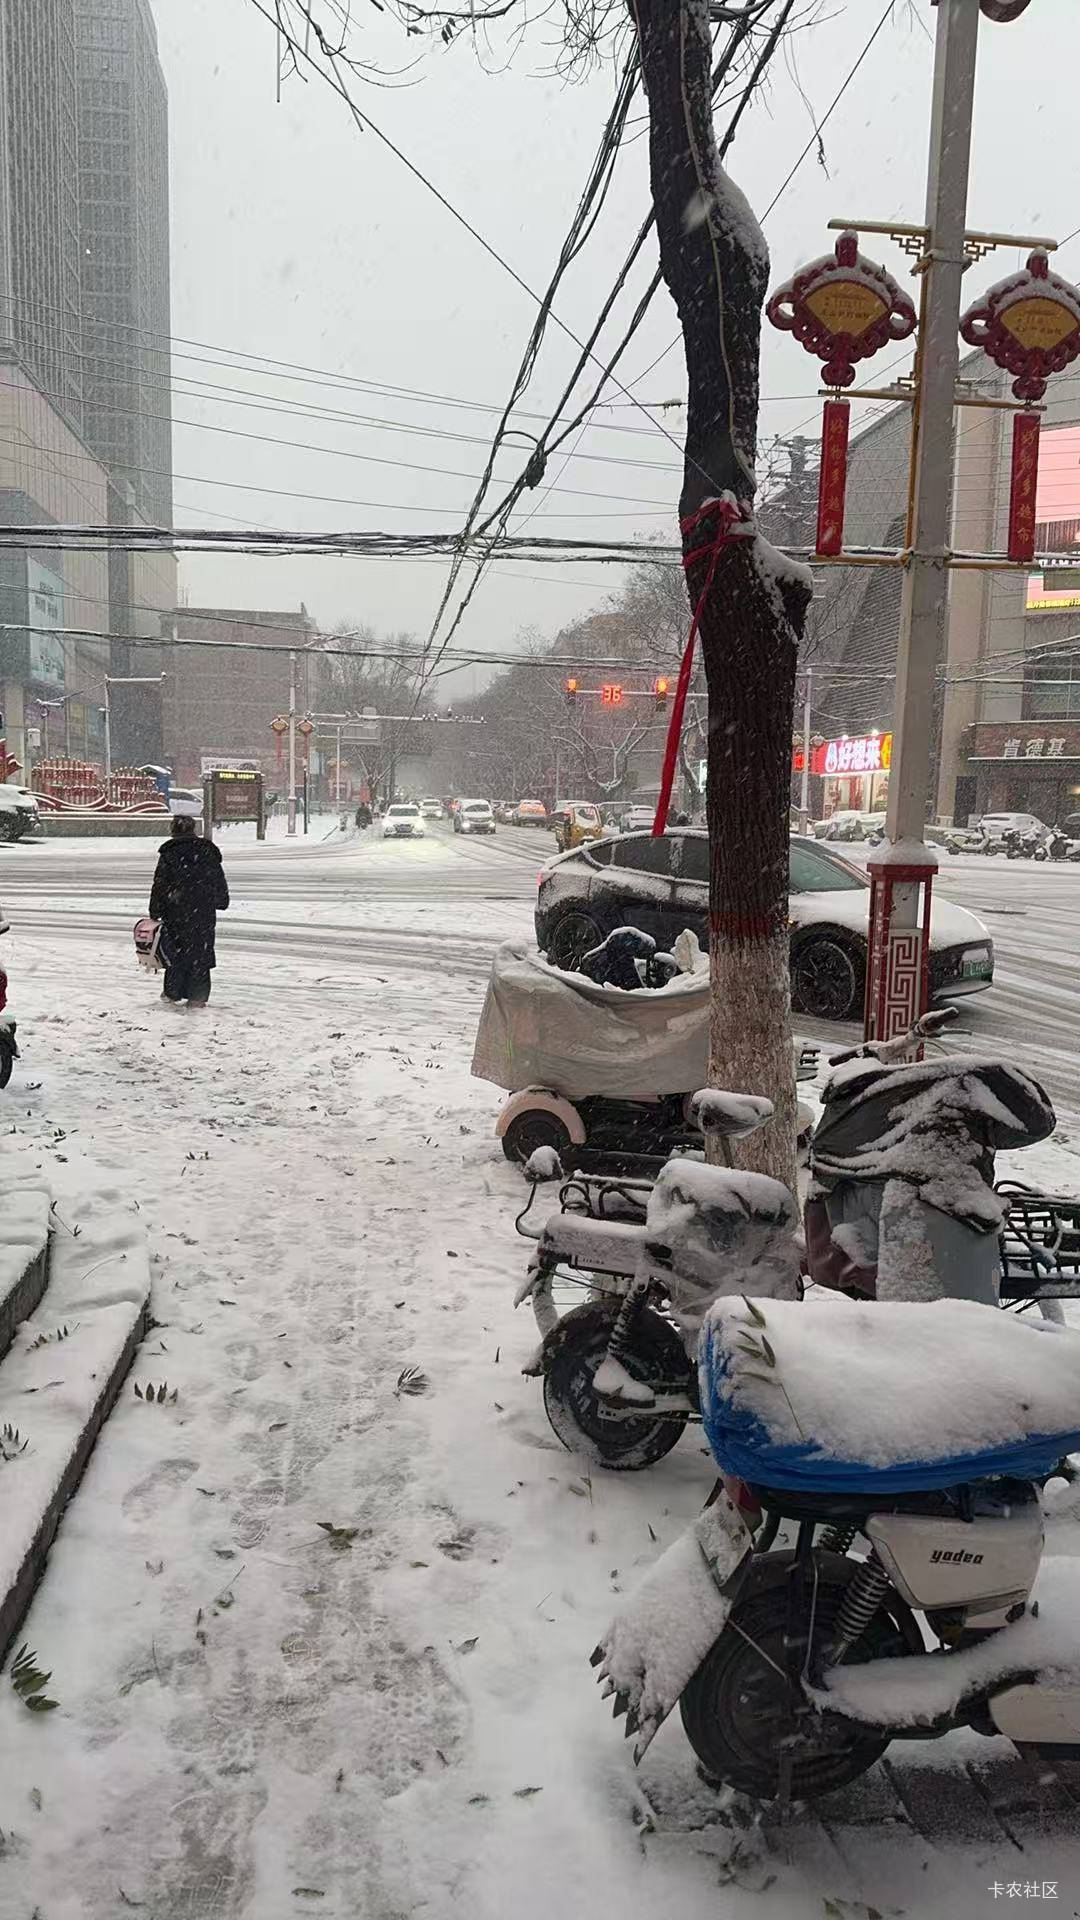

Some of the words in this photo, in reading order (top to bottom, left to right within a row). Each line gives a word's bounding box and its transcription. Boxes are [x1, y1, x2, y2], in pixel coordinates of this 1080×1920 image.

[604, 687, 621, 701] 36
[838, 738, 881, 771] 好想来
[1003, 738, 1066, 758] 肯德基
[929, 1549, 985, 1564] yadea
